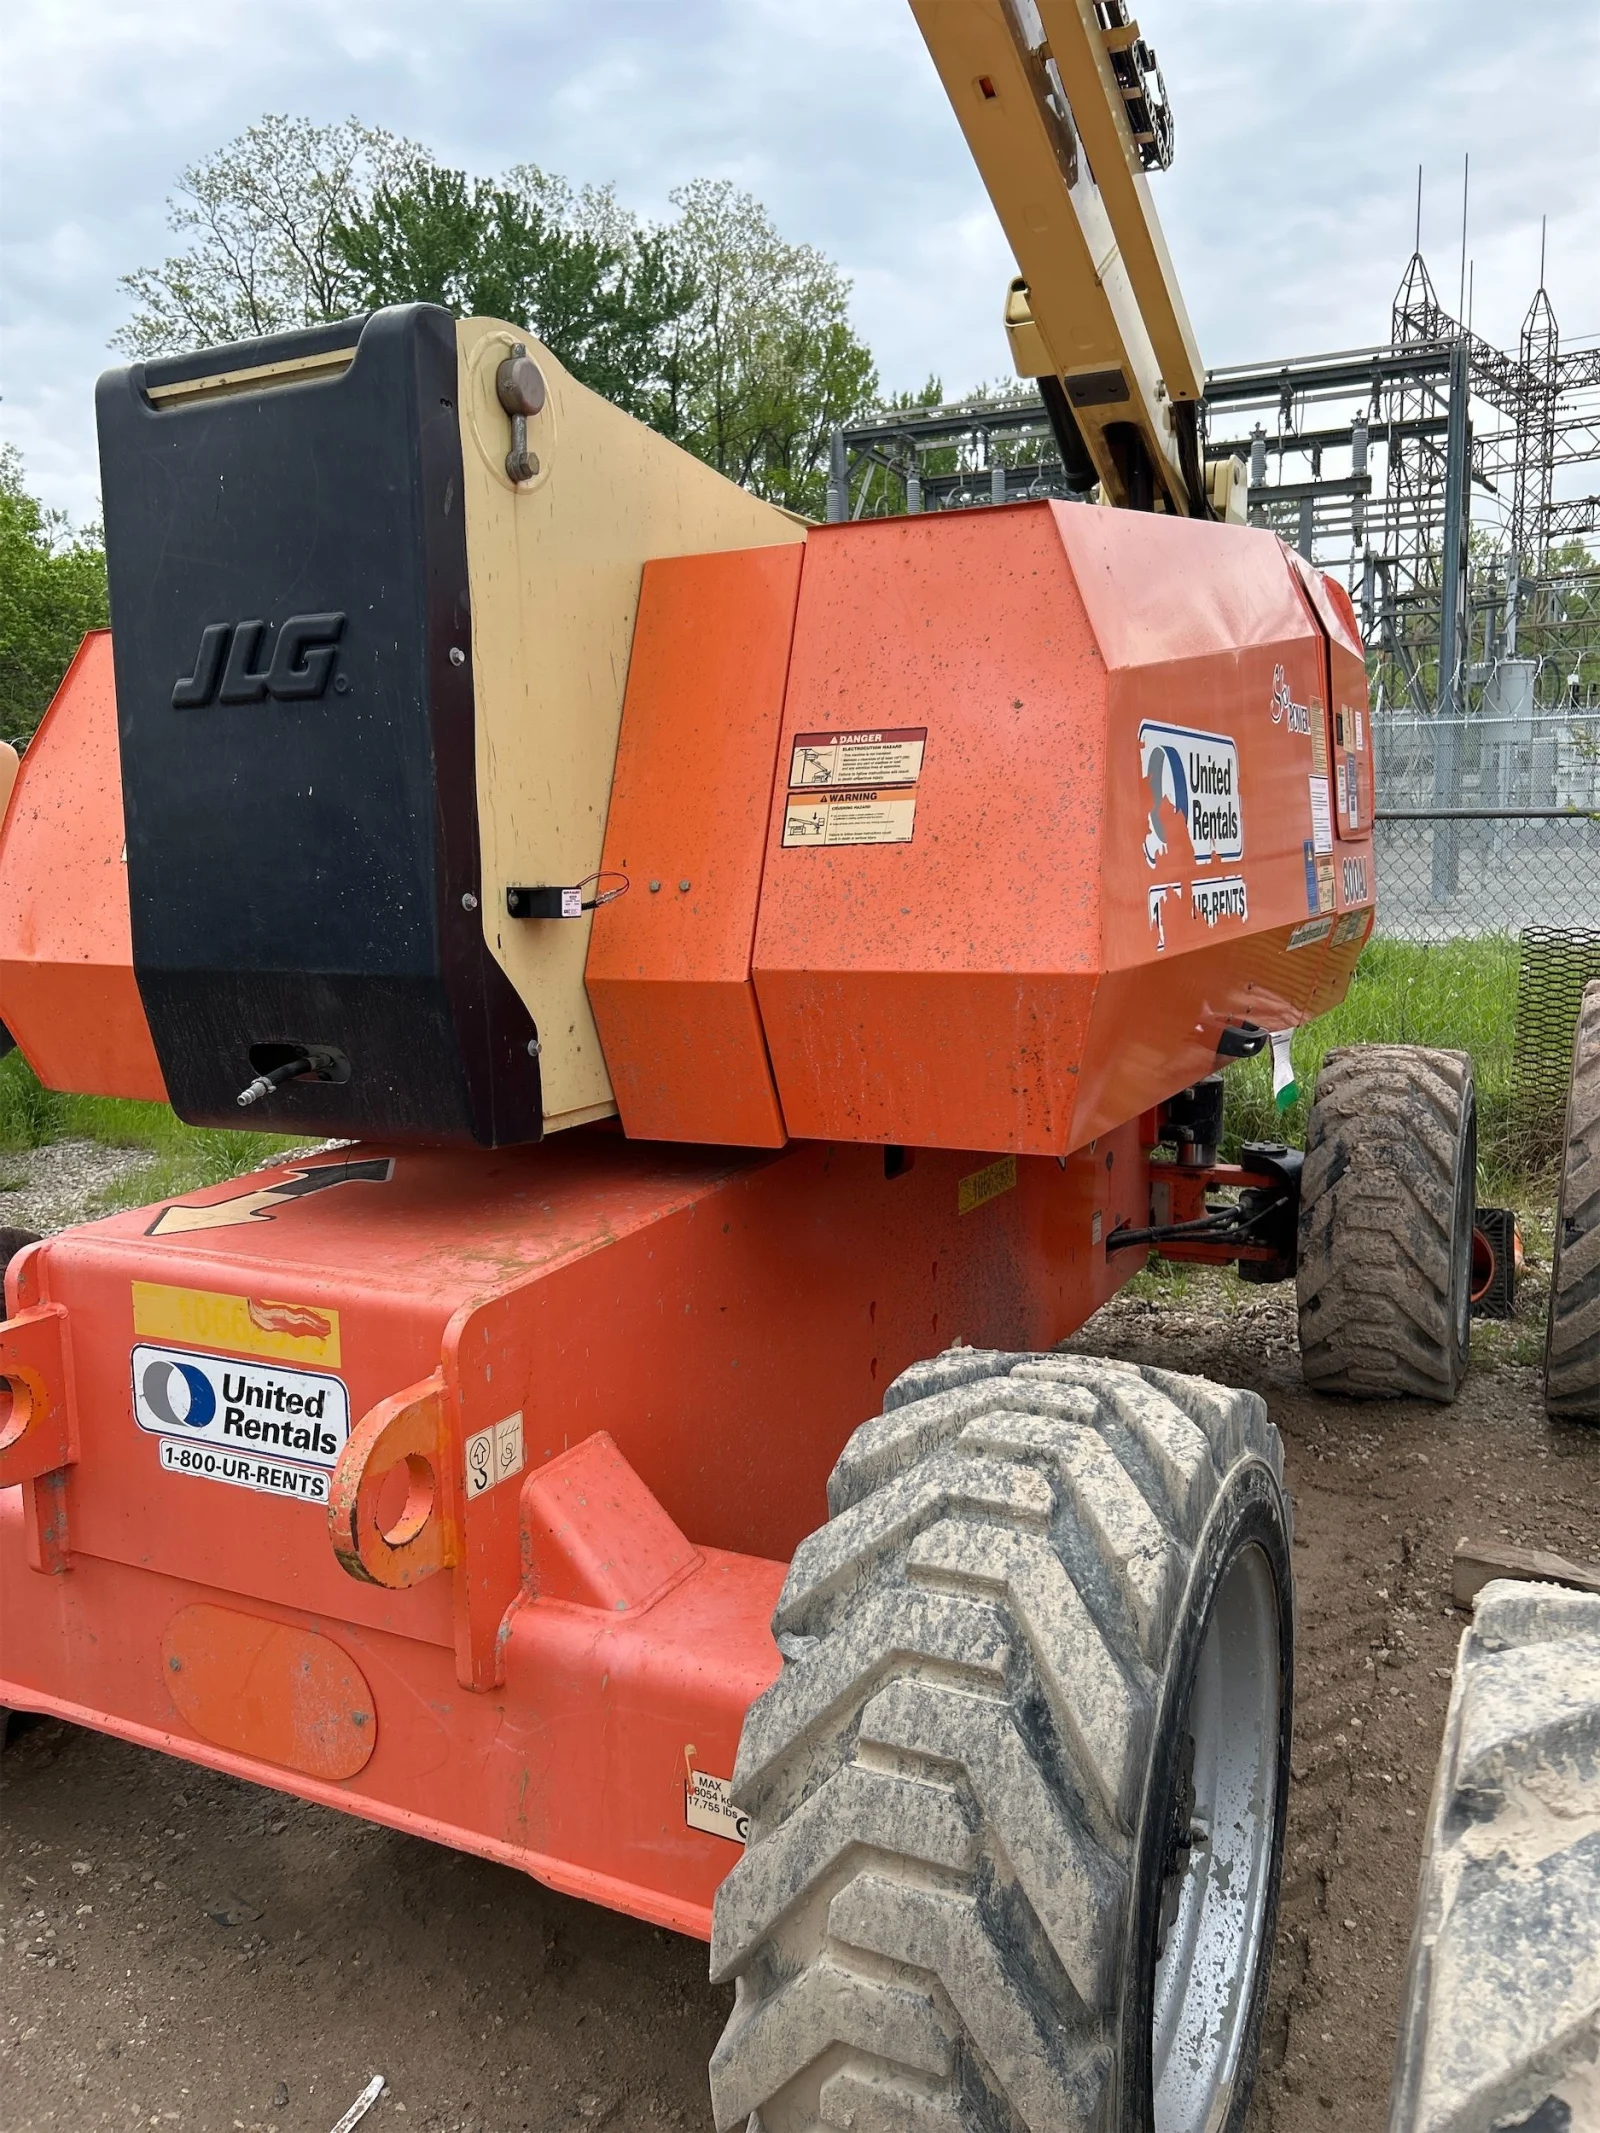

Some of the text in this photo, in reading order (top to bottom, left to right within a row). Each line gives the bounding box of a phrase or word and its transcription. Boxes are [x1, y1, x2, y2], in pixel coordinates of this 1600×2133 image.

[172, 612, 345, 708] JLG
[839, 734, 882, 744] DANGER
[1190, 752, 1231, 795] United
[829, 792, 877, 802] WARNING
[1192, 799, 1238, 841] Rentals
[1343, 855, 1368, 906] 800AJ
[222, 1373, 326, 1419] United
[223, 1407, 337, 1455] Rentals
[165, 1447, 325, 1497] 1-800-UR-RENTS
[694, 1786, 733, 1808] 8054 kg
[699, 1777, 722, 1792] MAX
[688, 1796, 738, 1819] 17,755 lbs
